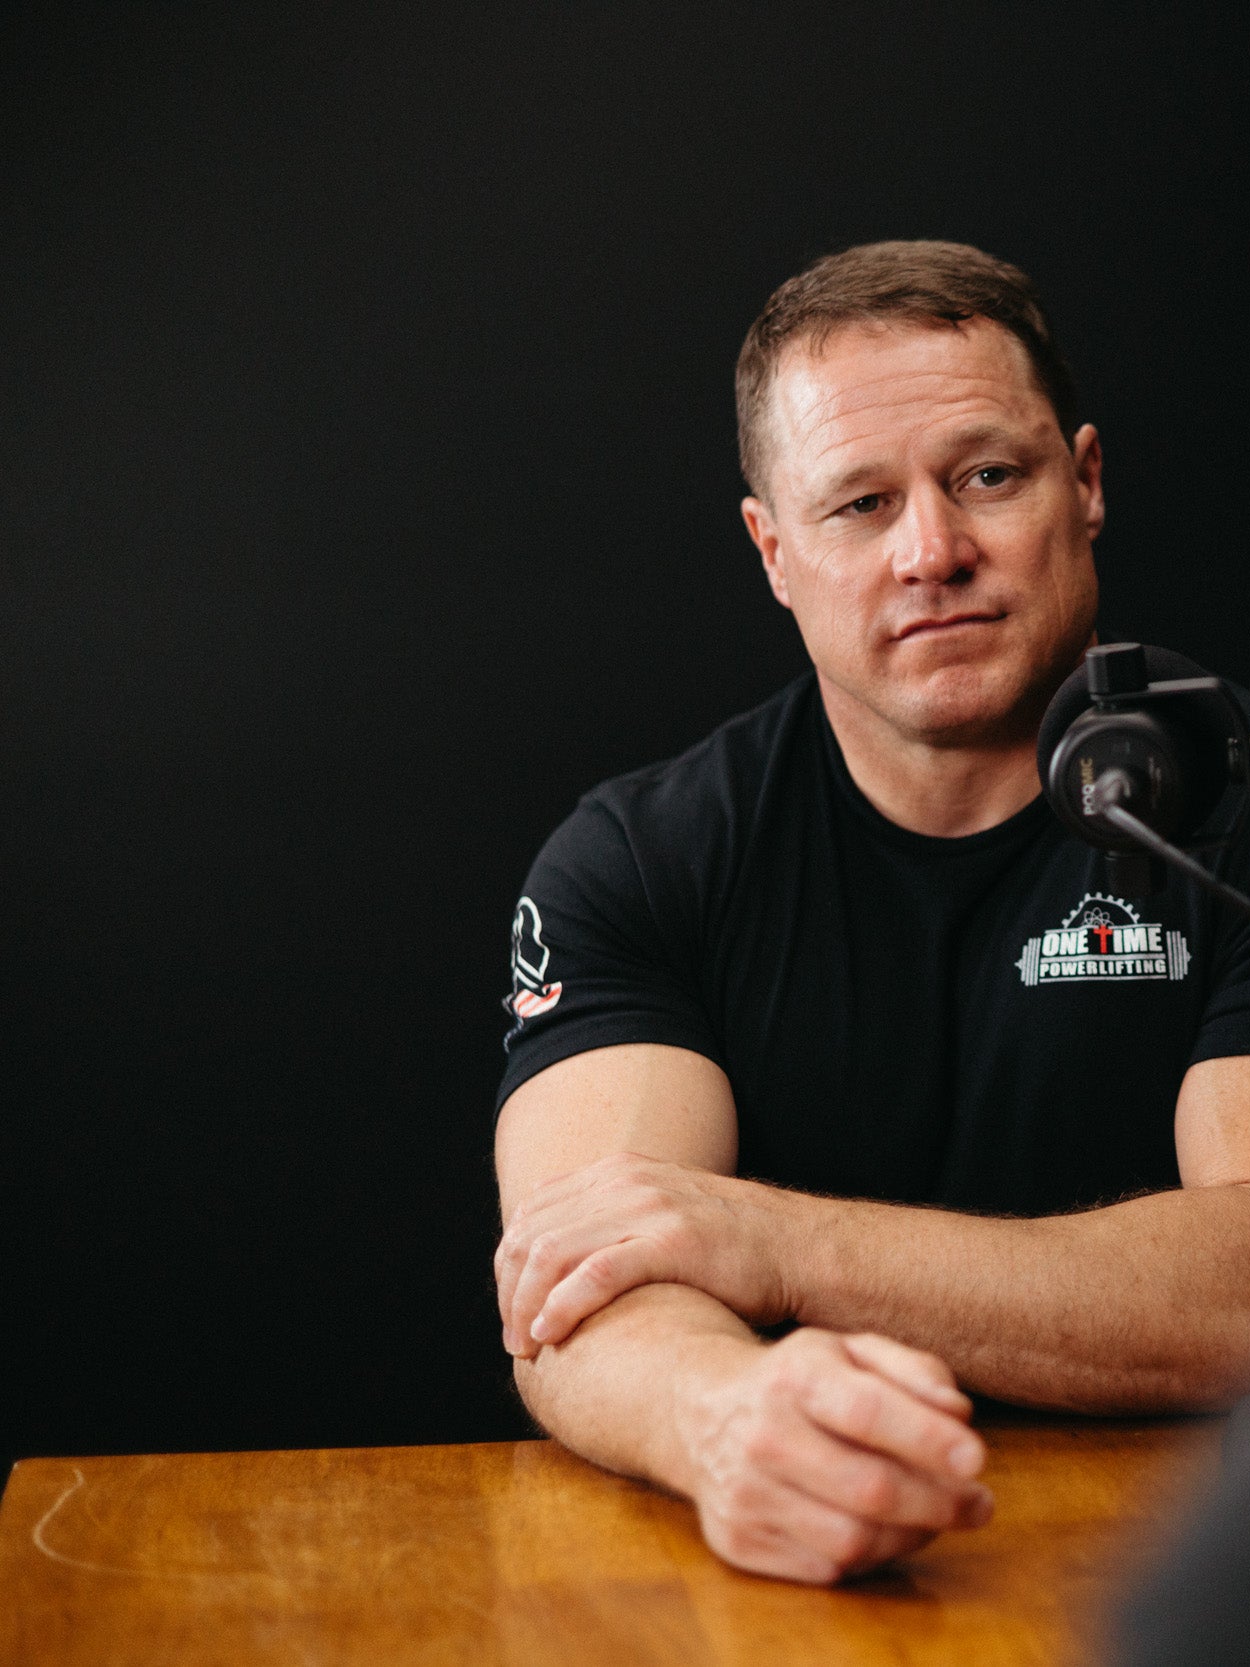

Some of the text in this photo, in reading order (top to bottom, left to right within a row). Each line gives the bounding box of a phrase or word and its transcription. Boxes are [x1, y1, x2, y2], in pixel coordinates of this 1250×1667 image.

[1041, 924, 1163, 956] ONE TIME
[1039, 959, 1167, 978] POWERLIFTING
